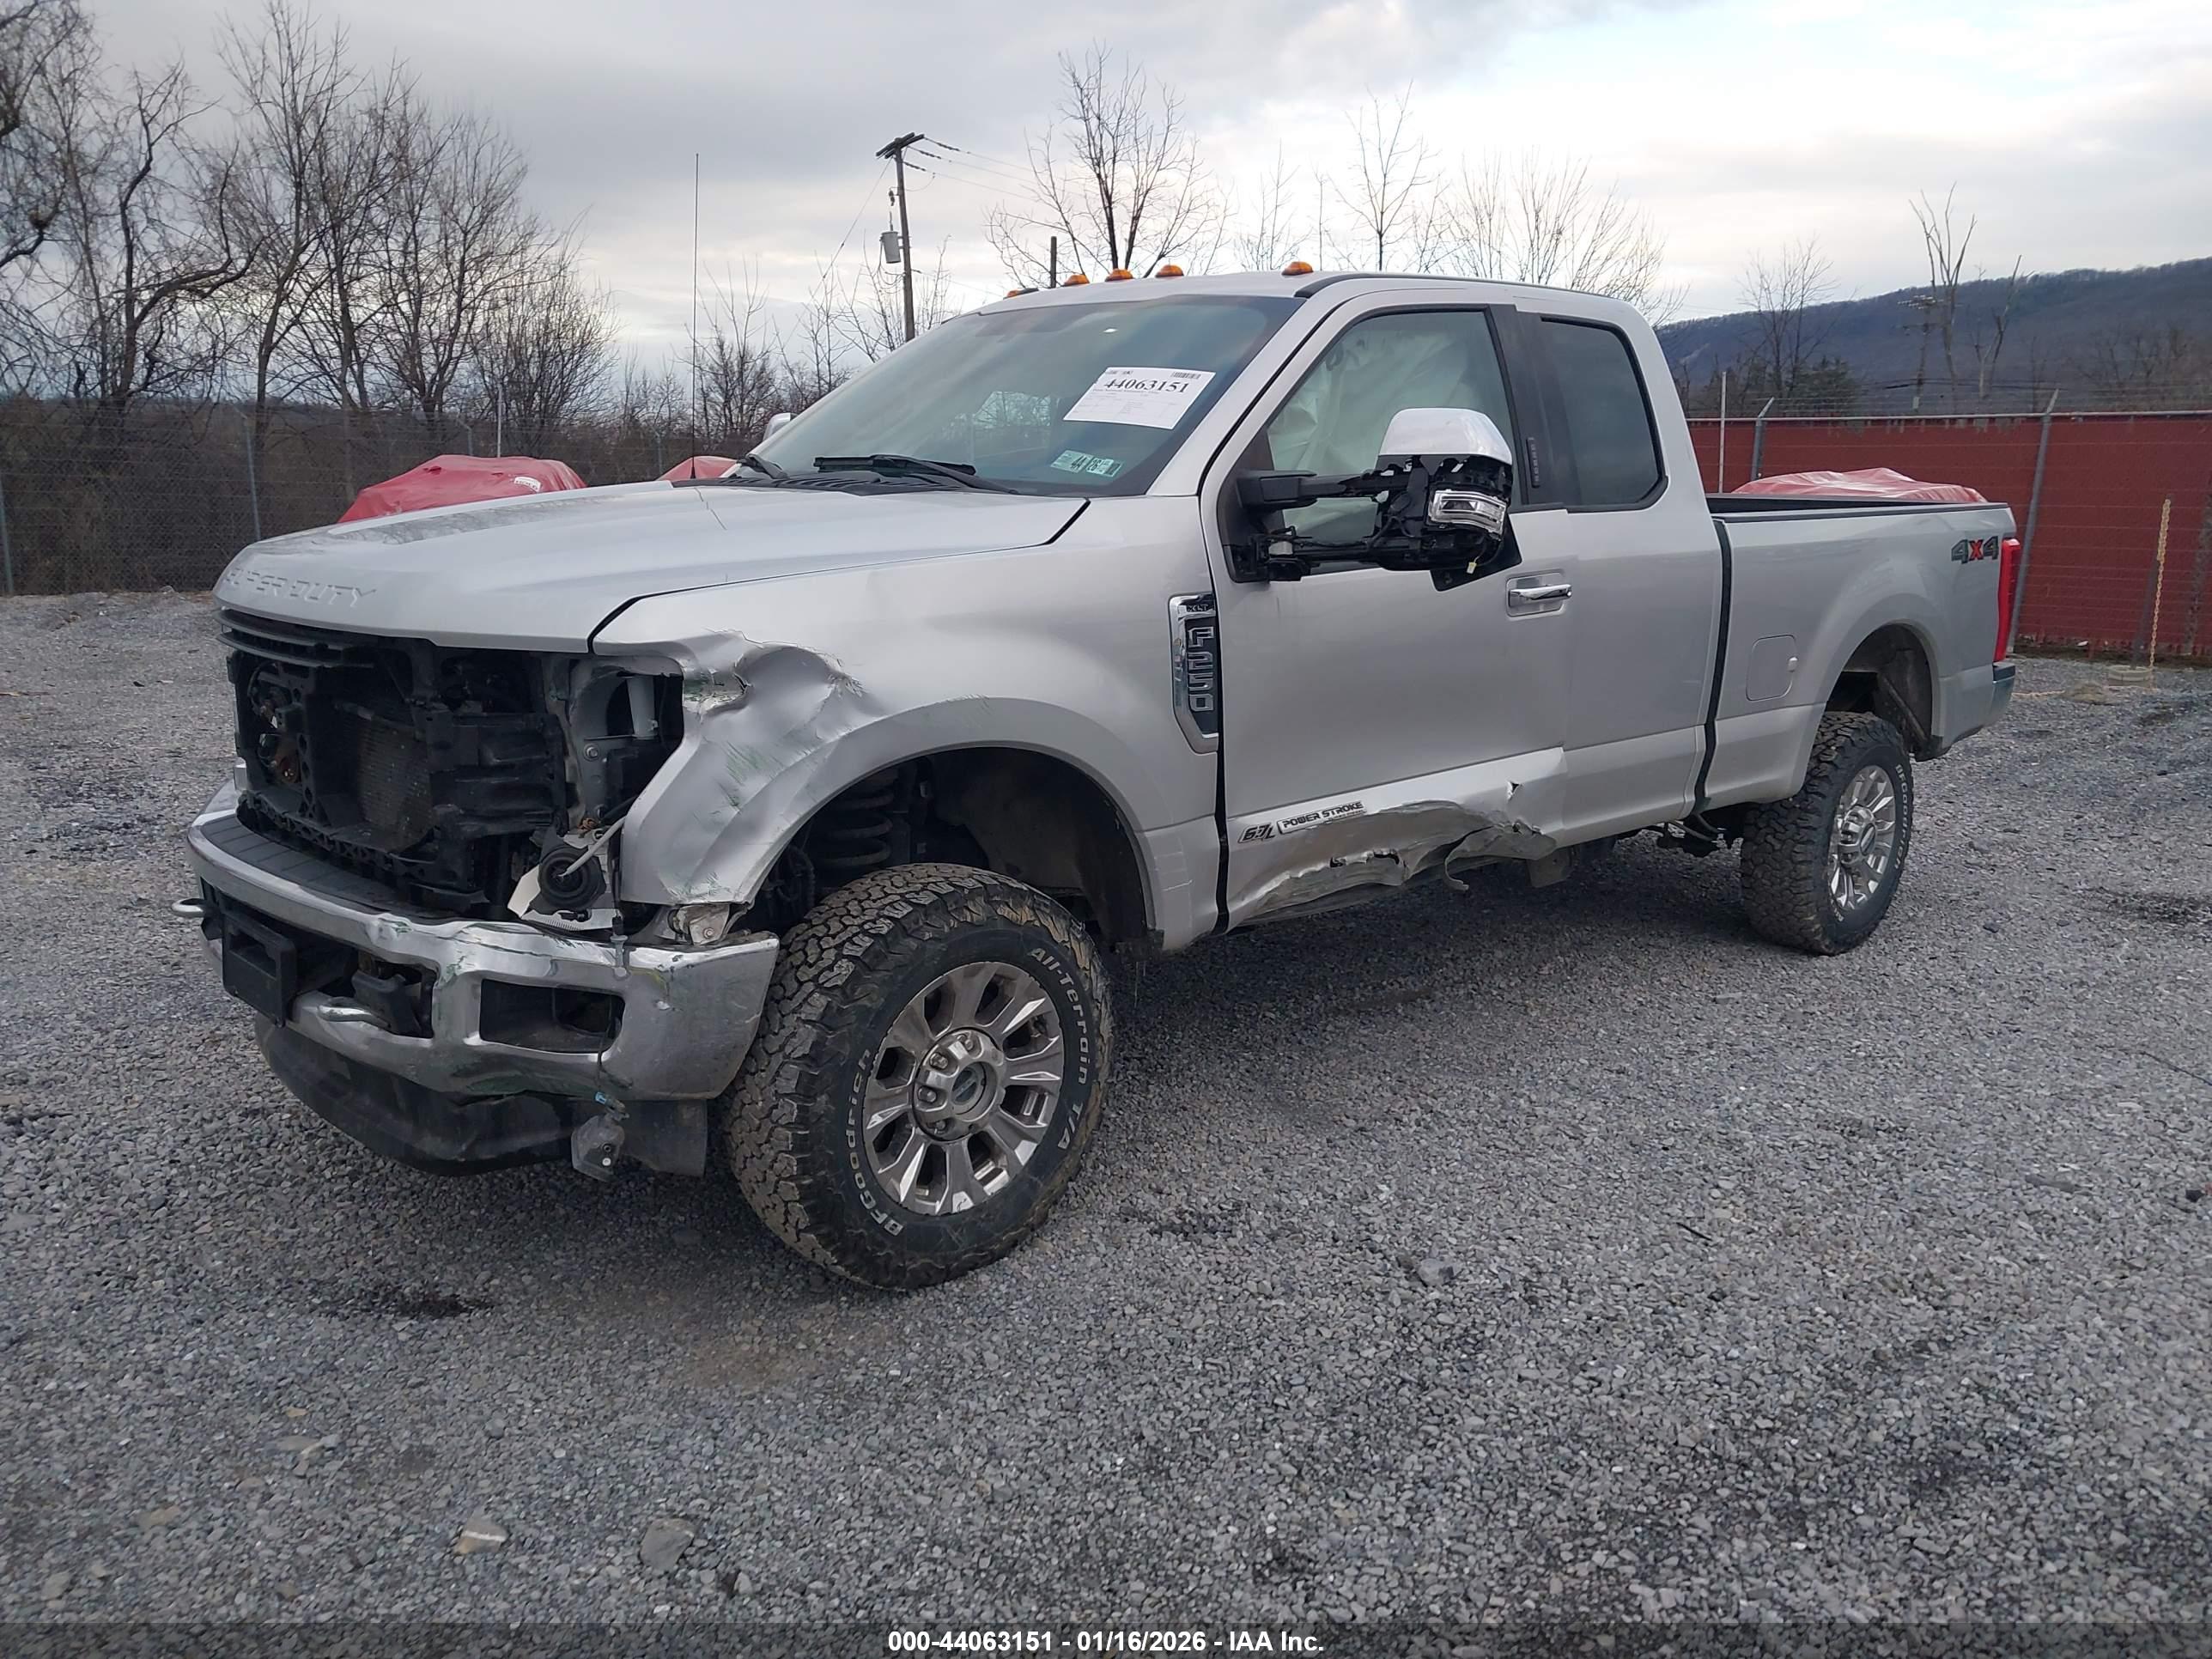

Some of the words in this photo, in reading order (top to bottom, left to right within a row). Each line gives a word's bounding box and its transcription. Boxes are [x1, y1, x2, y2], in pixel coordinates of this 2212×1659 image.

[1103, 378, 1190, 393] 44063151
[289, 579, 378, 608] DUTY
[1188, 626, 1214, 712] F250
[1282, 812, 1321, 829] POWER
[1321, 801, 1364, 817] STROKE
[1031, 947, 1091, 1085] All-Terrain
[845, 1048, 903, 1237] BFGoodrich
[1057, 1102, 1084, 1149] T/A
